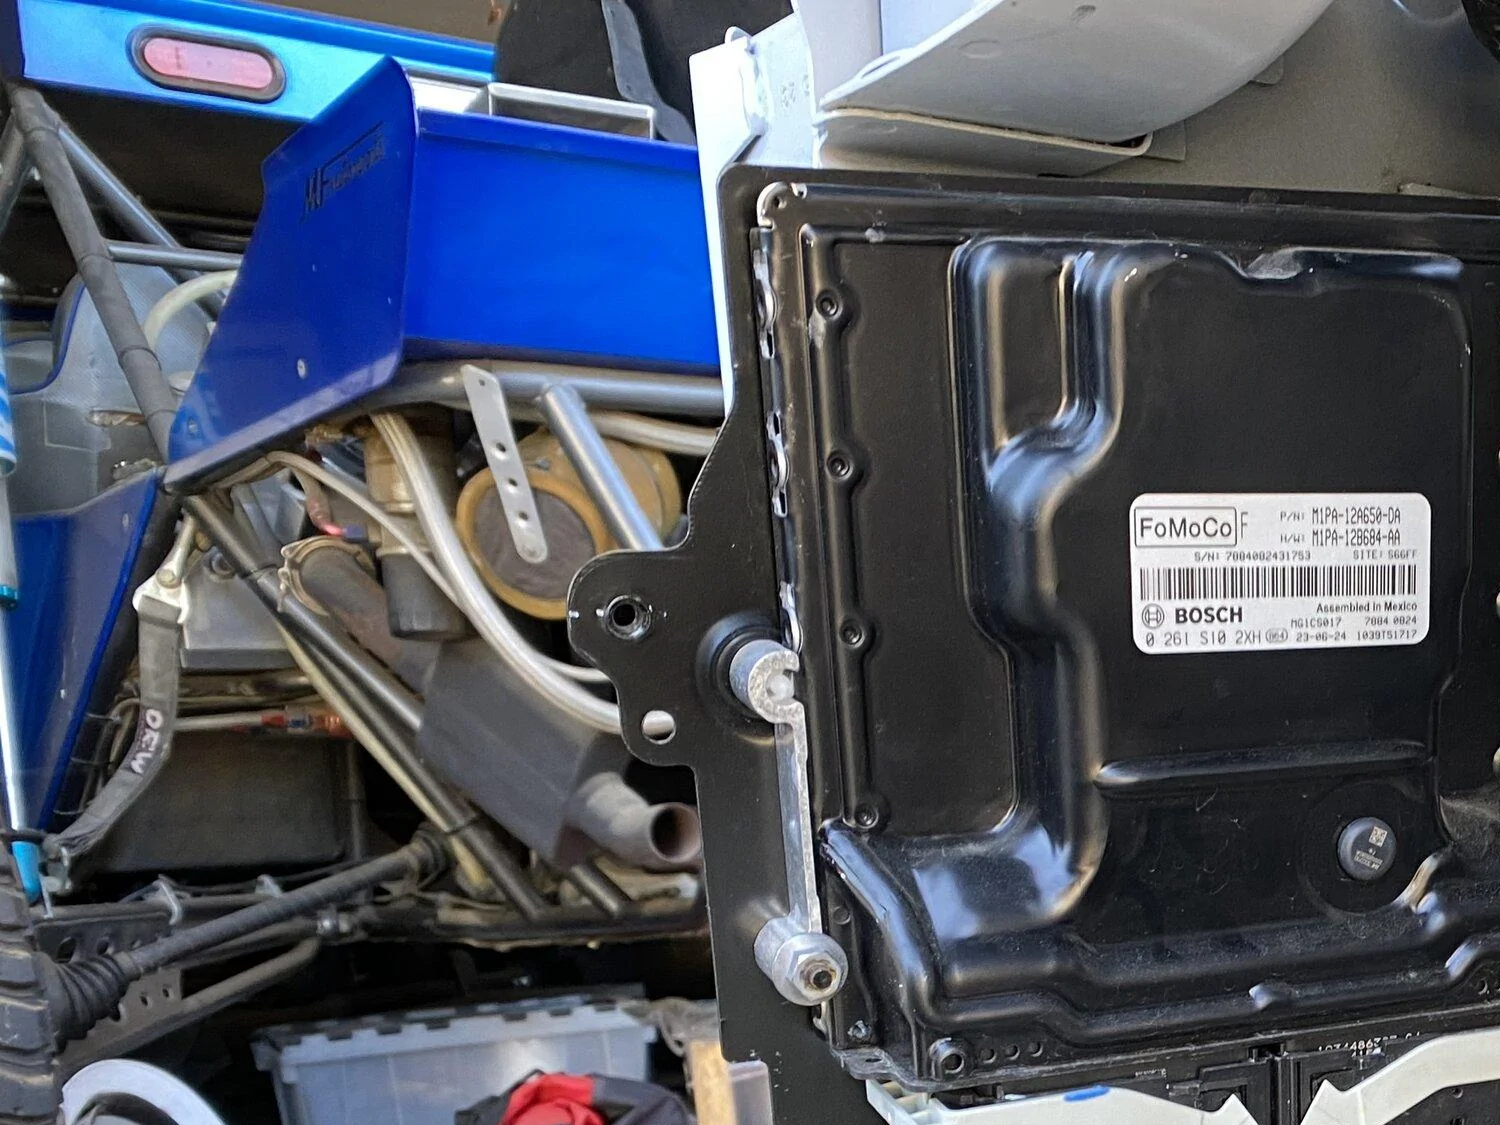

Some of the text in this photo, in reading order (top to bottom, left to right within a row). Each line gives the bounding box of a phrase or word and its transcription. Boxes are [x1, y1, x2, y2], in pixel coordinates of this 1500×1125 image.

[1312, 506, 1401, 525] M1PA-12A650-DA
[1140, 517, 1232, 538] FoMoCo
[1312, 528, 1401, 547] M1PA-12B684-AA
[1175, 606, 1243, 624] BOSCH
[1316, 602, 1370, 613] Assembled
[1384, 600, 1418, 611] Mexico
